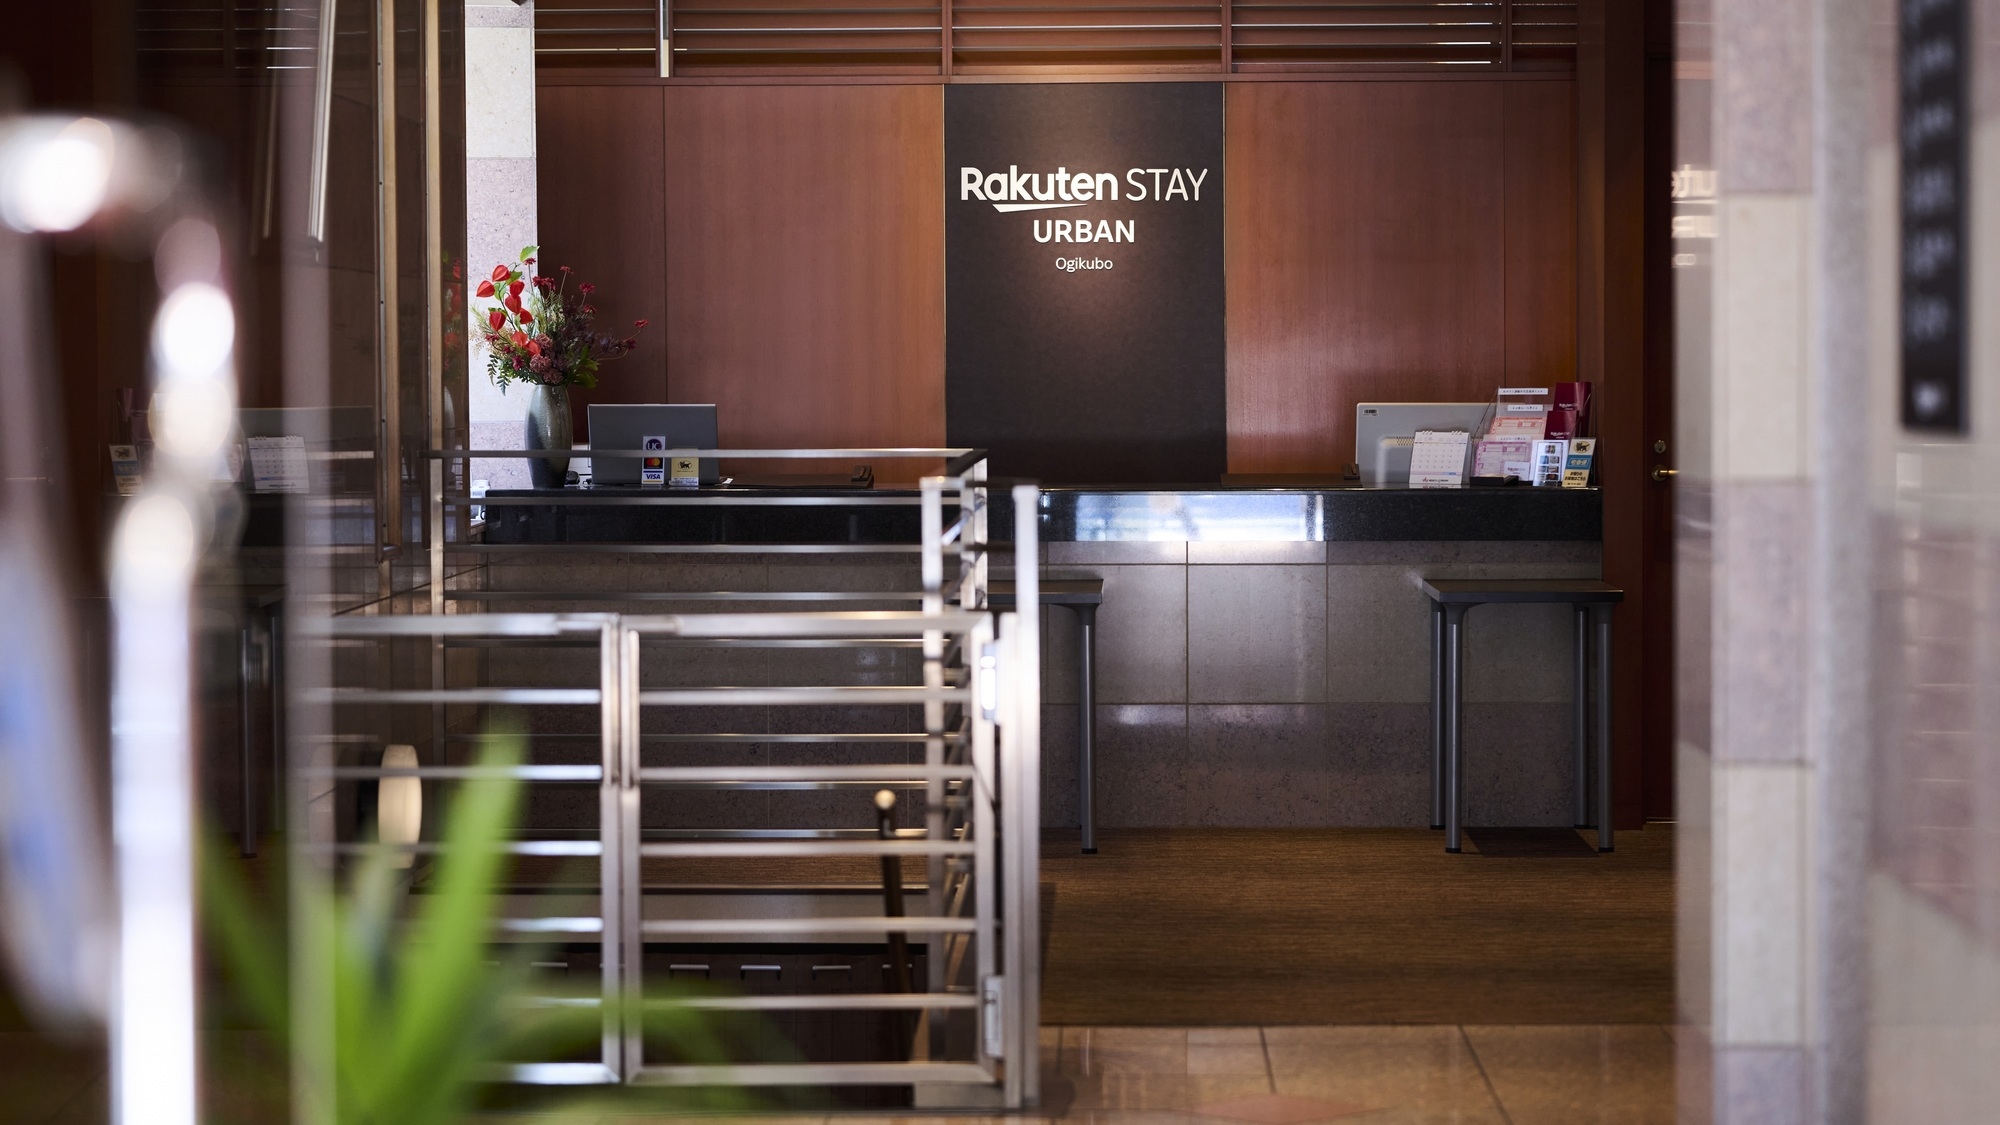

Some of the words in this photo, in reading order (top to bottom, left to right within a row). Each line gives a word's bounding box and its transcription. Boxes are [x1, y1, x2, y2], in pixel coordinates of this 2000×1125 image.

[961, 165, 1118, 202] Rakuten
[1126, 168, 1208, 202] STAY
[1033, 219, 1135, 243] URBAN
[1055, 257, 1113, 272] Ogikubo
